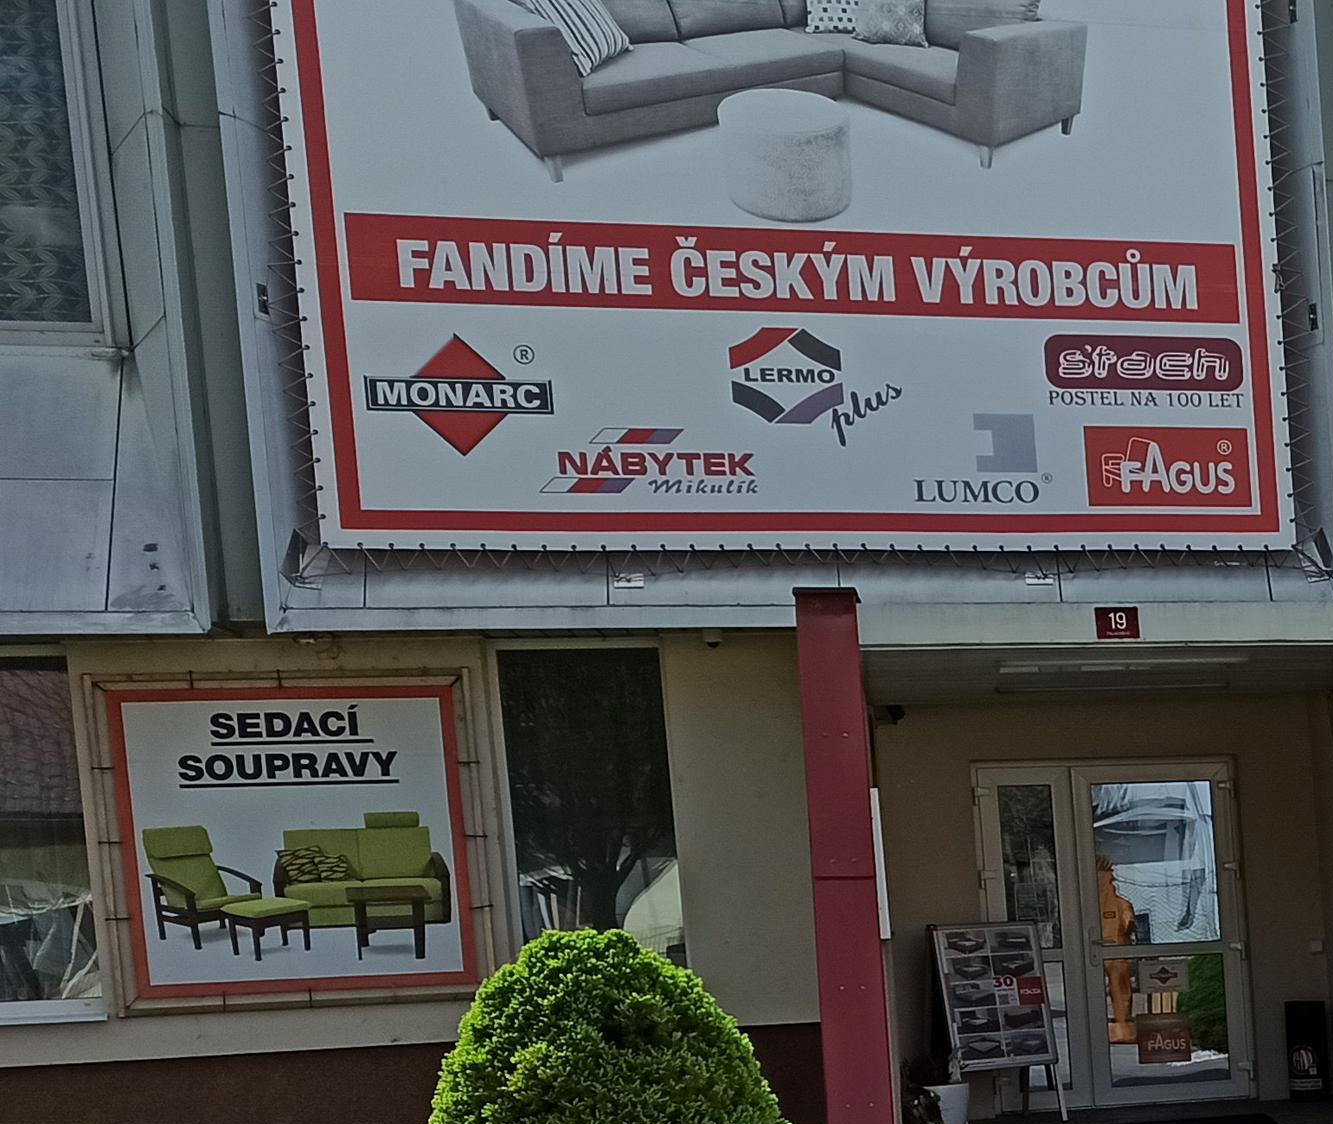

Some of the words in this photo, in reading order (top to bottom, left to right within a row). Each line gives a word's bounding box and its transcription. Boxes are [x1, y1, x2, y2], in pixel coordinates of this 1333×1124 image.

[396, 232, 652, 296] FANDÍME
[670, 236, 896, 301] ČESKÝM
[911, 246, 1198, 310] VÝROBCŮM
[744, 367, 835, 383] LERMO
[376, 382, 541, 408] MONARC
[1049, 390, 1124, 407] POSTEL
[1130, 392, 1159, 407] NA
[1167, 393, 1201, 408] 100
[1208, 393, 1244, 408] LET
[831, 383, 902, 446] plus
[558, 446, 754, 476] NÁBYTEK
[1120, 441, 1236, 494] FAGUS
[648, 478, 758, 494] Mikulík
[914, 478, 1039, 503] LUMCO
[1108, 612, 1127, 630] 19
[210, 704, 359, 740] SEDACÍ
[178, 751, 398, 782] SOUPRAVY
[993, 975, 1014, 988] 30
[1147, 1033, 1186, 1052] FAGUS
